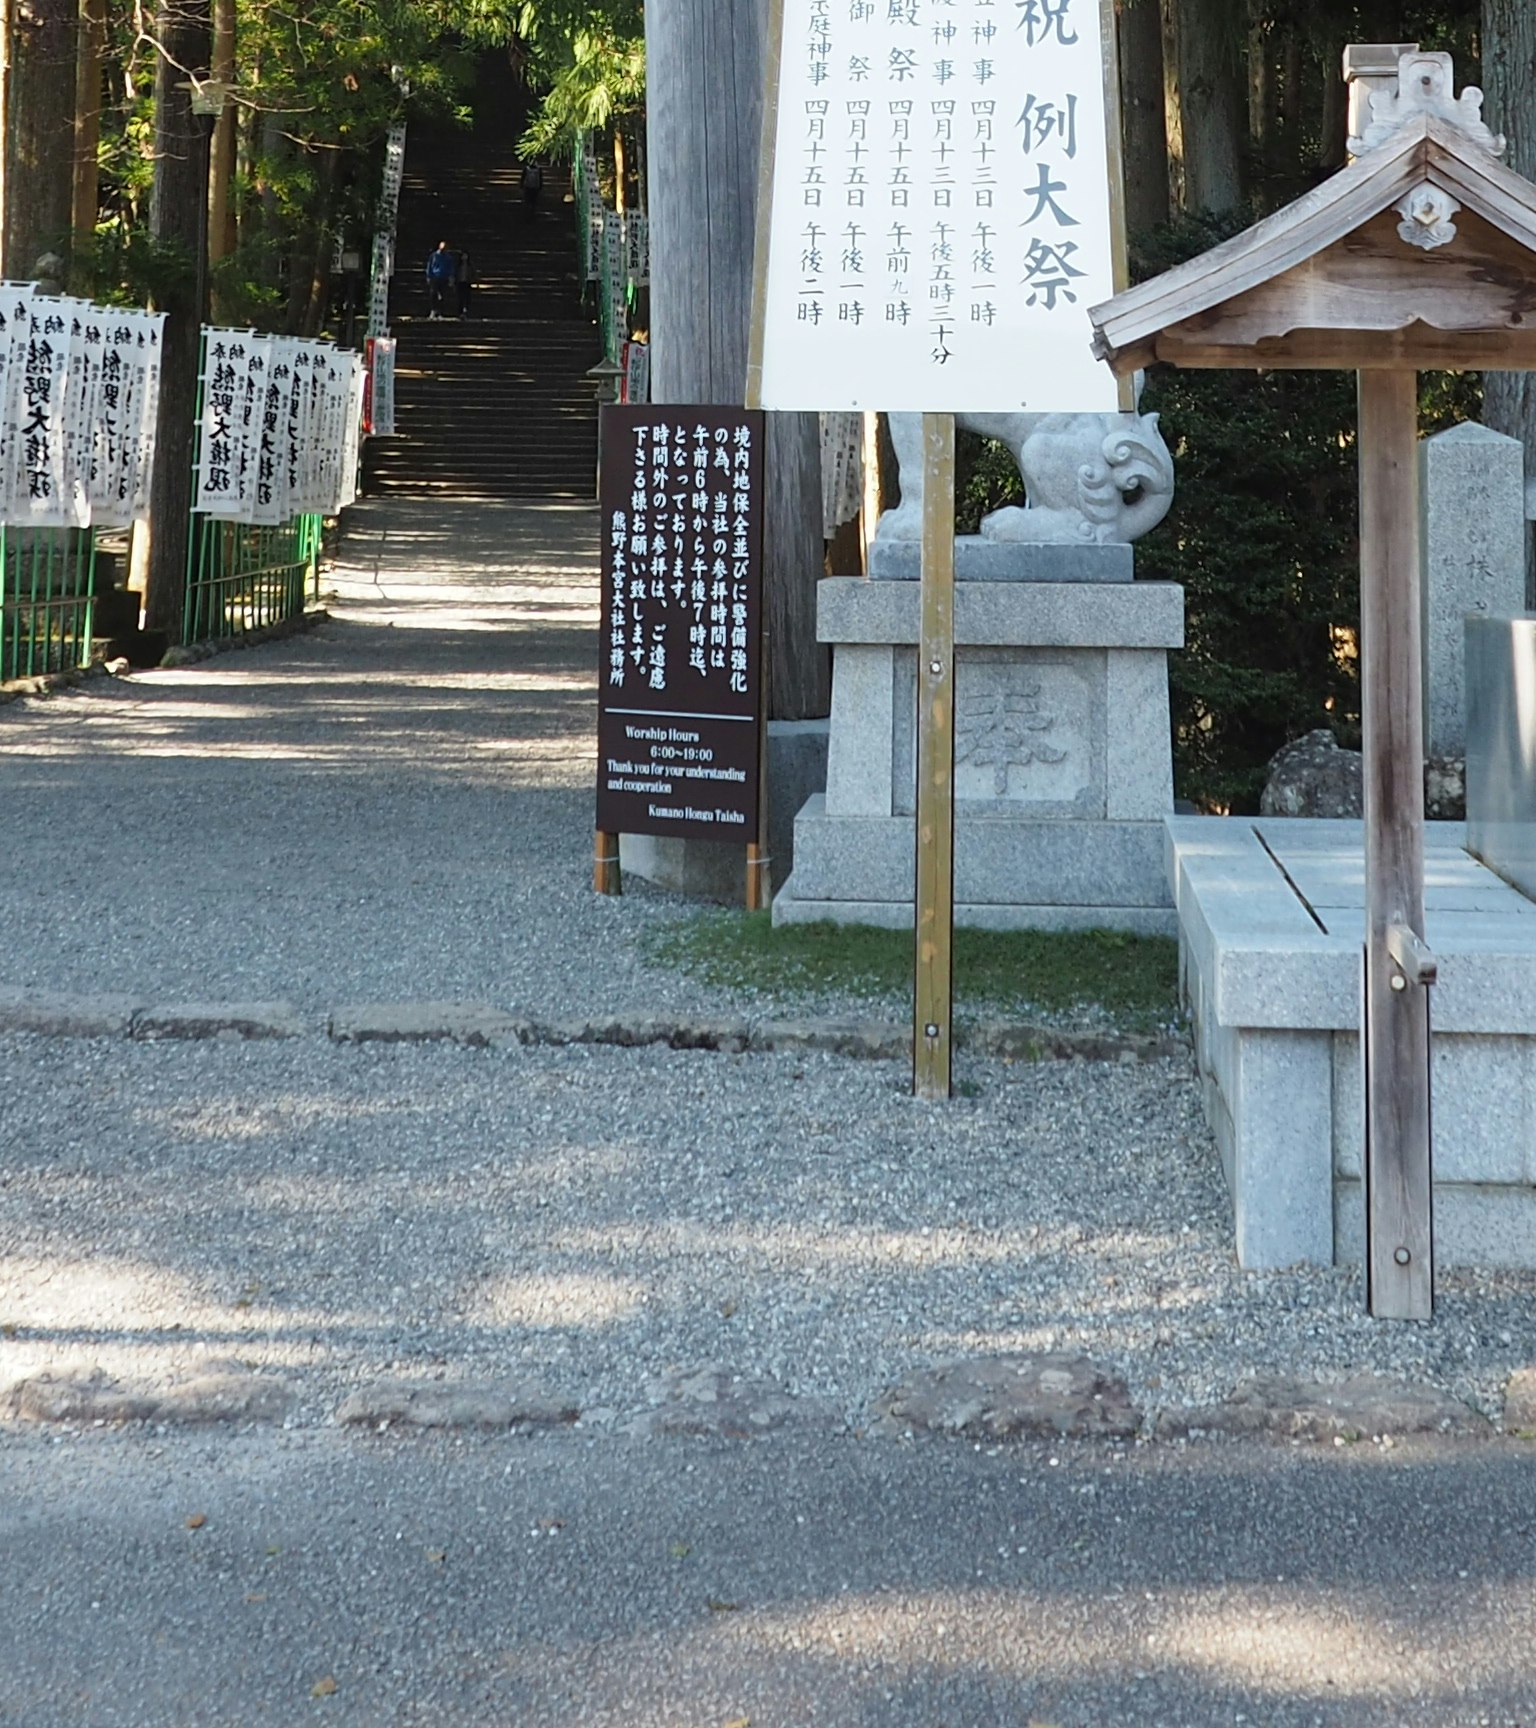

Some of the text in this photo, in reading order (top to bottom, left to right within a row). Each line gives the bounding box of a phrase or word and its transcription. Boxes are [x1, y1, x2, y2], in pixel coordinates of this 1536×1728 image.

[801, 99, 828, 208] 四月十五日
[843, 99, 871, 208] 四月十五日
[887, 99, 914, 208] 四月十五日
[929, 99, 957, 208] 四月十三日
[971, 99, 997, 208] 四月十三日
[1014, 93, 1089, 311] 例大祭
[797, 221, 826, 326] 午後二時
[838, 221, 866, 326] 午後一時
[885, 221, 912, 326] 午前九時
[928, 221, 955, 364] 午後五時三十分
[970, 222, 997, 327] 午後一時
[630, 427, 649, 675] 下さる様お願い致します。
[650, 424, 670, 608] 時間外のご参拝は、
[671, 425, 688, 608] となっております。
[730, 425, 751, 692] 境内地保全並びに警備強化
[610, 510, 627, 688] 熊野本宮大社社務所
[710, 492, 729, 668] 当社の参拝時間は
[607, 759, 746, 783] Thank you for your understanding
[607, 777, 672, 794] and cooperation
[625, 725, 700, 743] Worship Hours
[648, 803, 745, 824] Kumano Hongu Taisha
